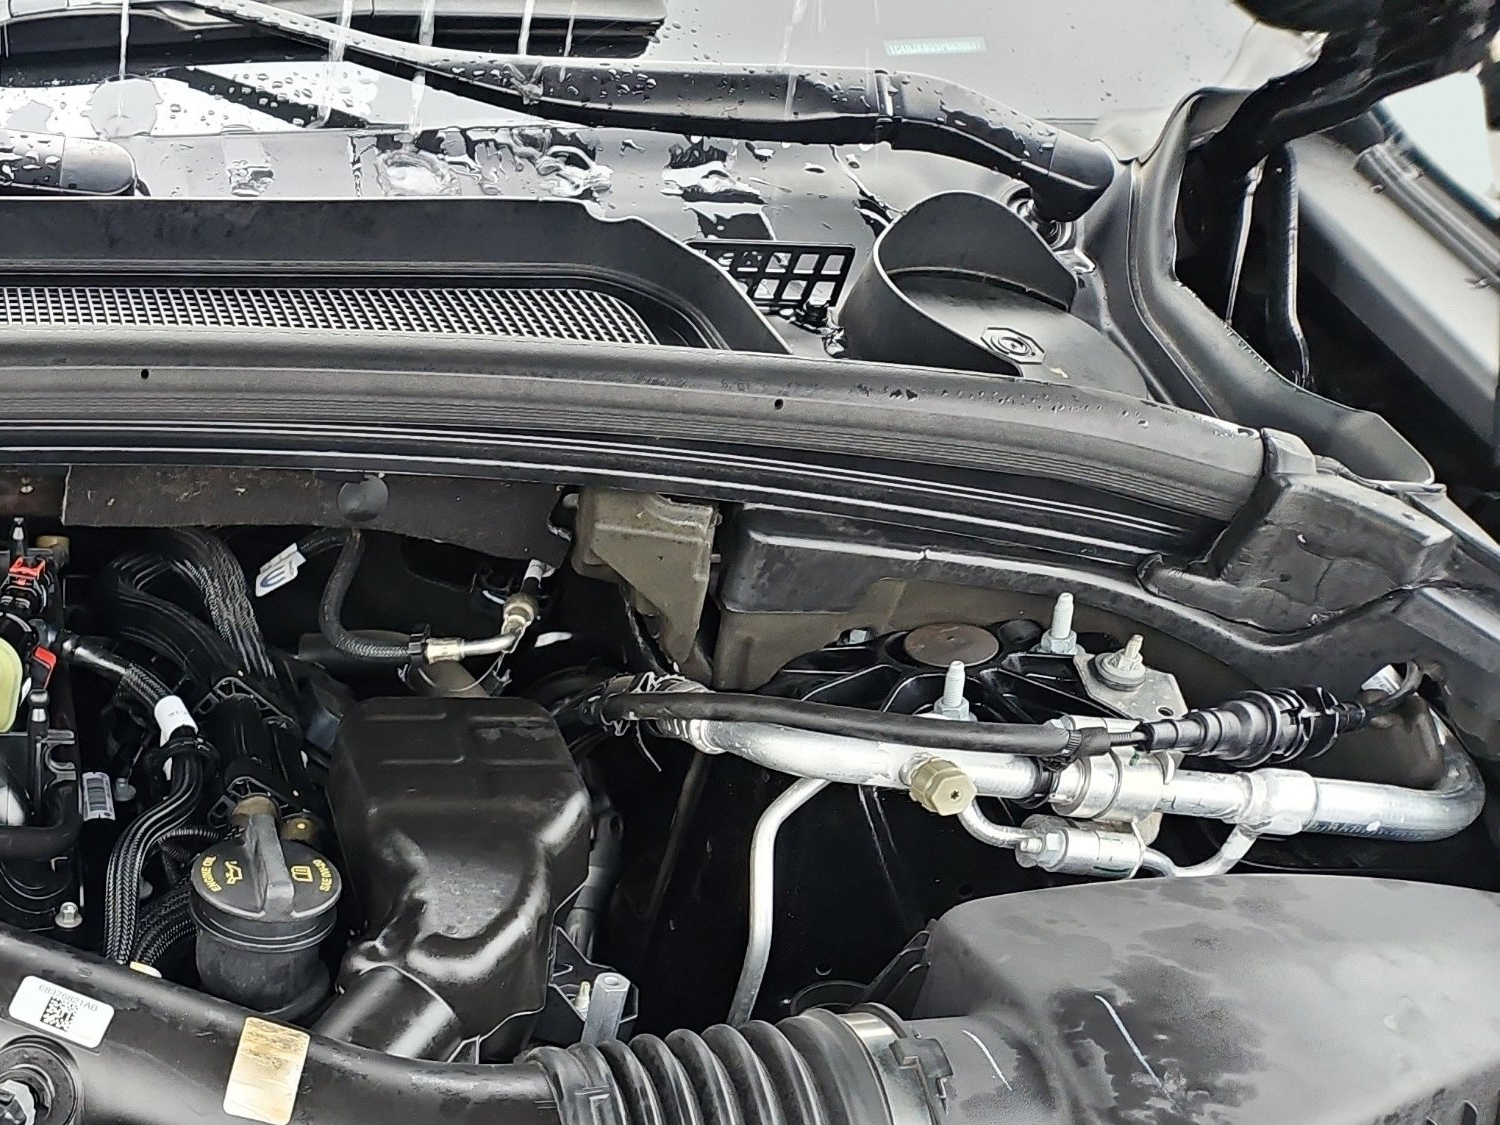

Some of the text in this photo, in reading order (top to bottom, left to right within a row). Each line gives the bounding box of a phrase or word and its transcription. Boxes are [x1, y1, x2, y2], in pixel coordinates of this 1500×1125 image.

[200, 855, 222, 893] ENGINE OIL
[319, 878, 333, 892] SAE
